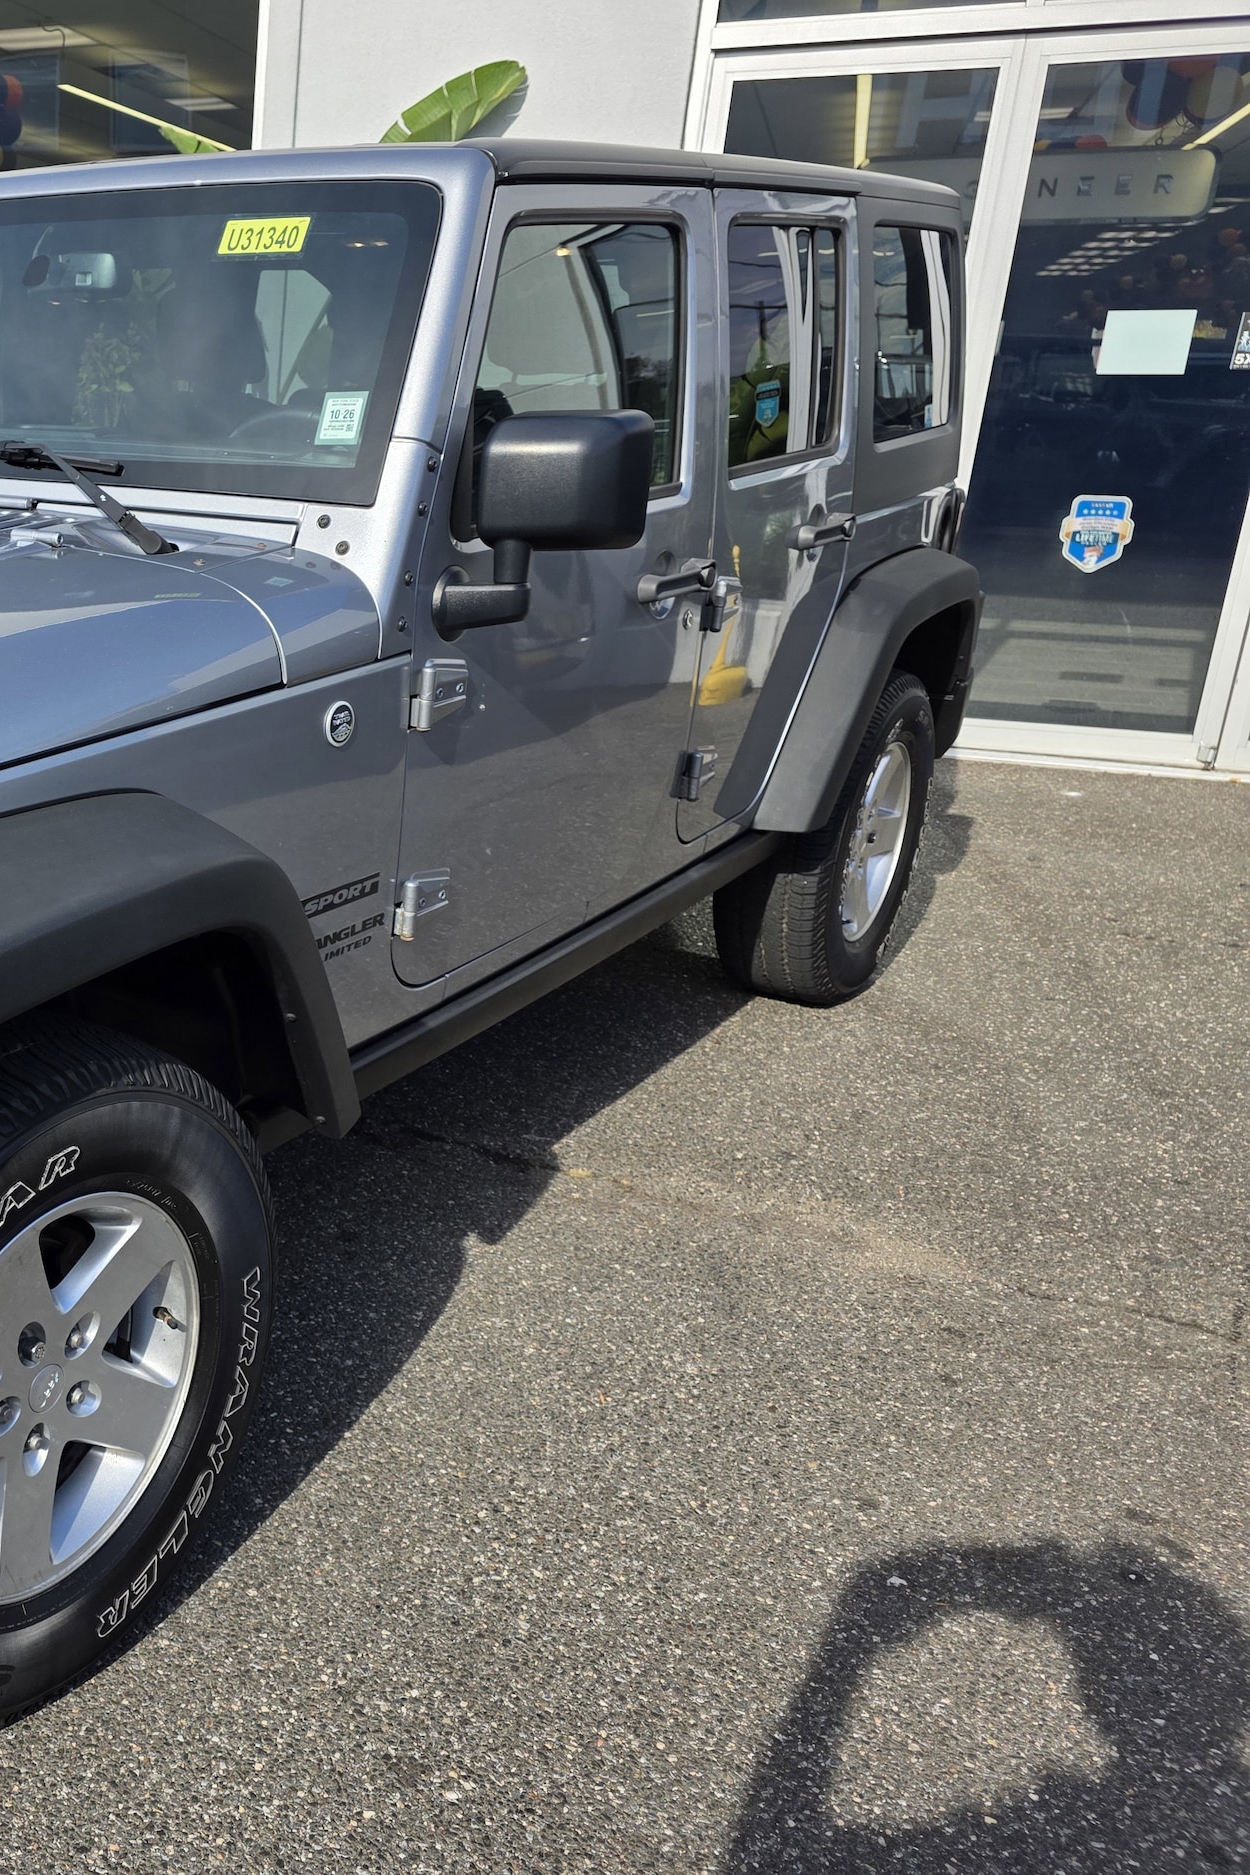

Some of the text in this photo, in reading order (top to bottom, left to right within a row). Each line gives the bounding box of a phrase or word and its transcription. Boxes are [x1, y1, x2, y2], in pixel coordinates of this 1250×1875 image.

[227, 225, 300, 251] U31340
[304, 879, 374, 916] SPORT
[324, 935, 372, 961] IMITED
[97, 1266, 261, 1638] WRANGLER
